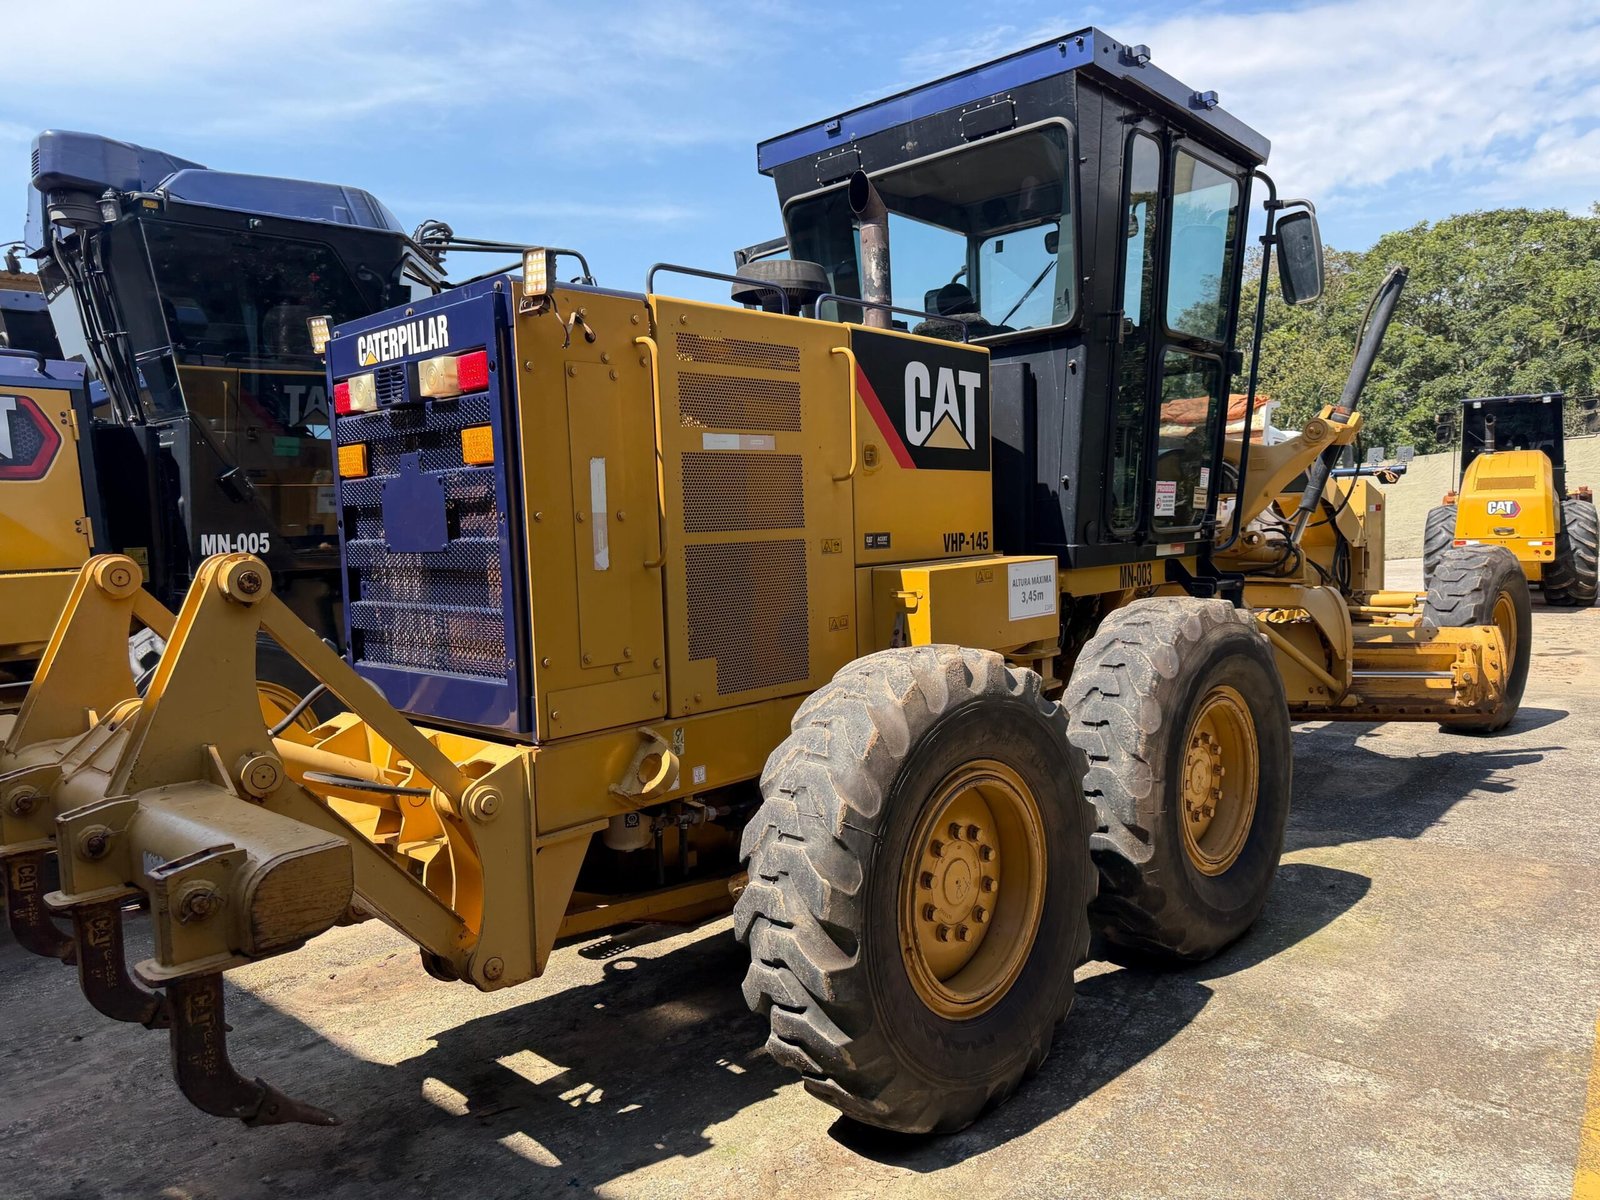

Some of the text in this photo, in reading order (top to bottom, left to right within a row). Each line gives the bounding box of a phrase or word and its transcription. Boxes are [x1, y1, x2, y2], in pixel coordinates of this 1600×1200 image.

[357, 315, 449, 366] CATERPILLAR
[904, 360, 981, 451] CAT
[1488, 501, 1513, 515] CAT
[200, 532, 271, 556] MN-005
[943, 531, 989, 553] VHP-145
[1012, 573, 1052, 588] ALTURA MÁXIMA
[1119, 563, 1152, 589] MN-003
[1021, 589, 1044, 604] 3,45m
[18, 864, 38, 890] CAT
